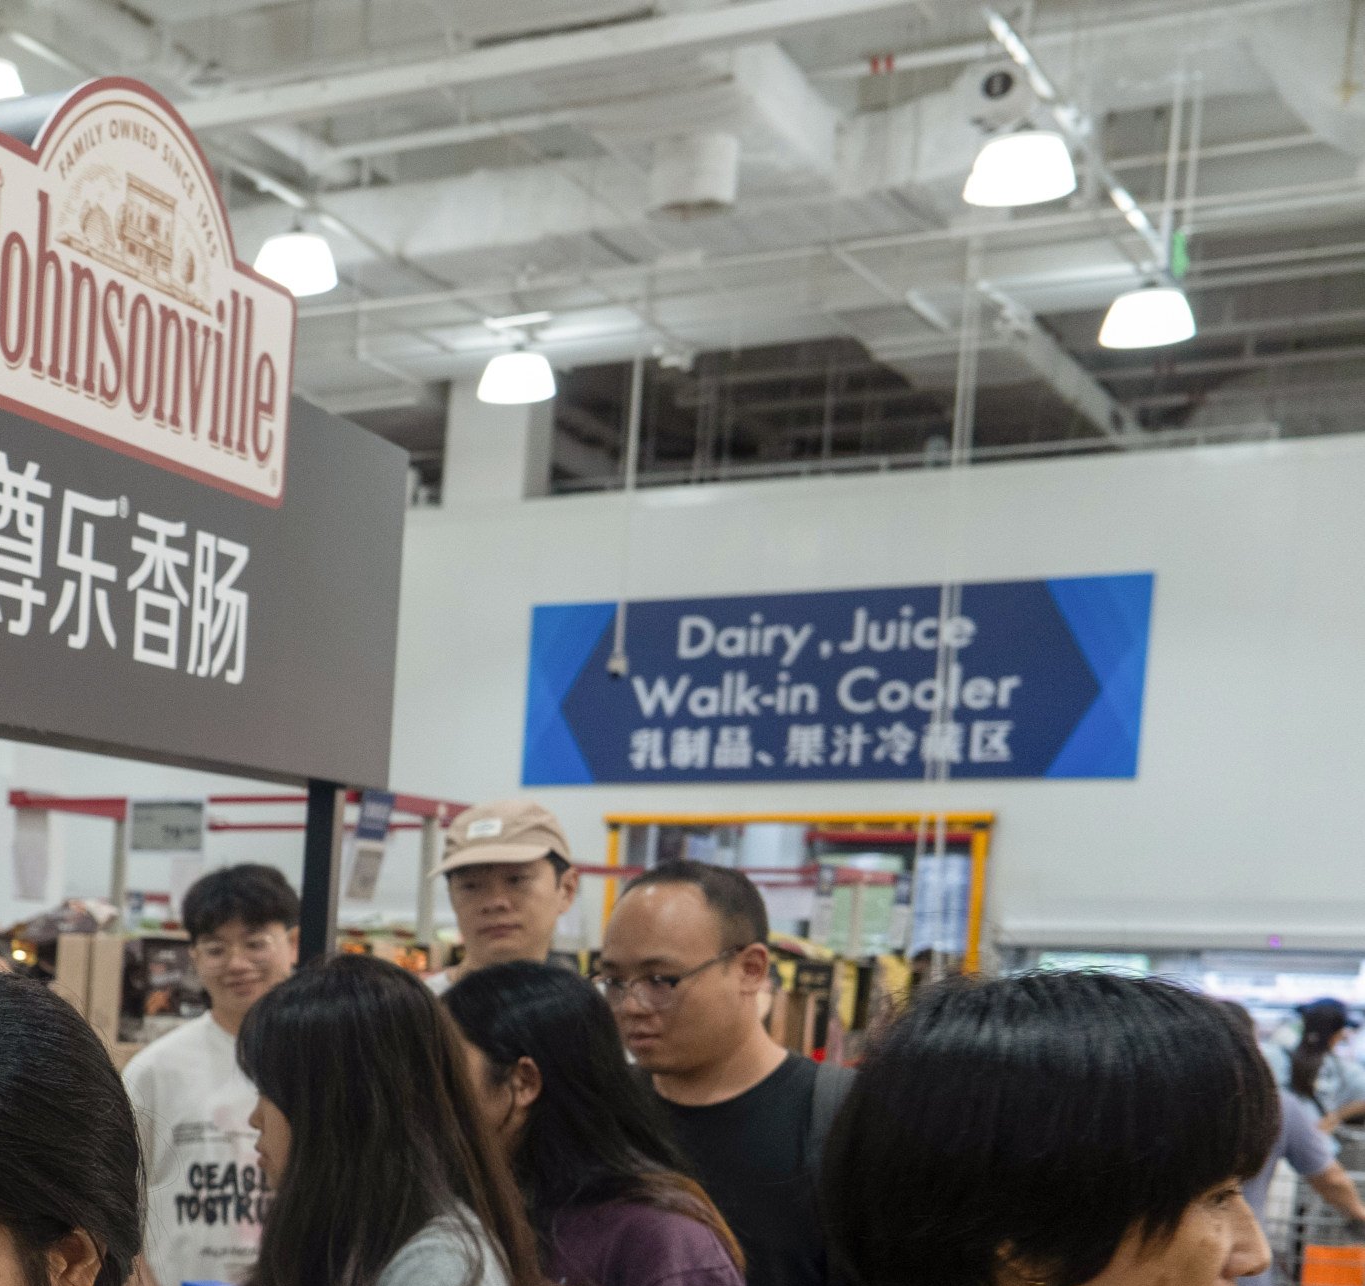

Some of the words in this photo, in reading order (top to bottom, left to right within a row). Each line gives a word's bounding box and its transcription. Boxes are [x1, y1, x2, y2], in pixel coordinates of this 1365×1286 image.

[59, 123, 103, 180] FAMILY
[109, 119, 158, 150] OWNED
[162, 143, 195, 200] SINCE
[839, 605, 977, 655] Juice
[631, 670, 820, 718] Walk-in
[835, 662, 1023, 713] Cooler
